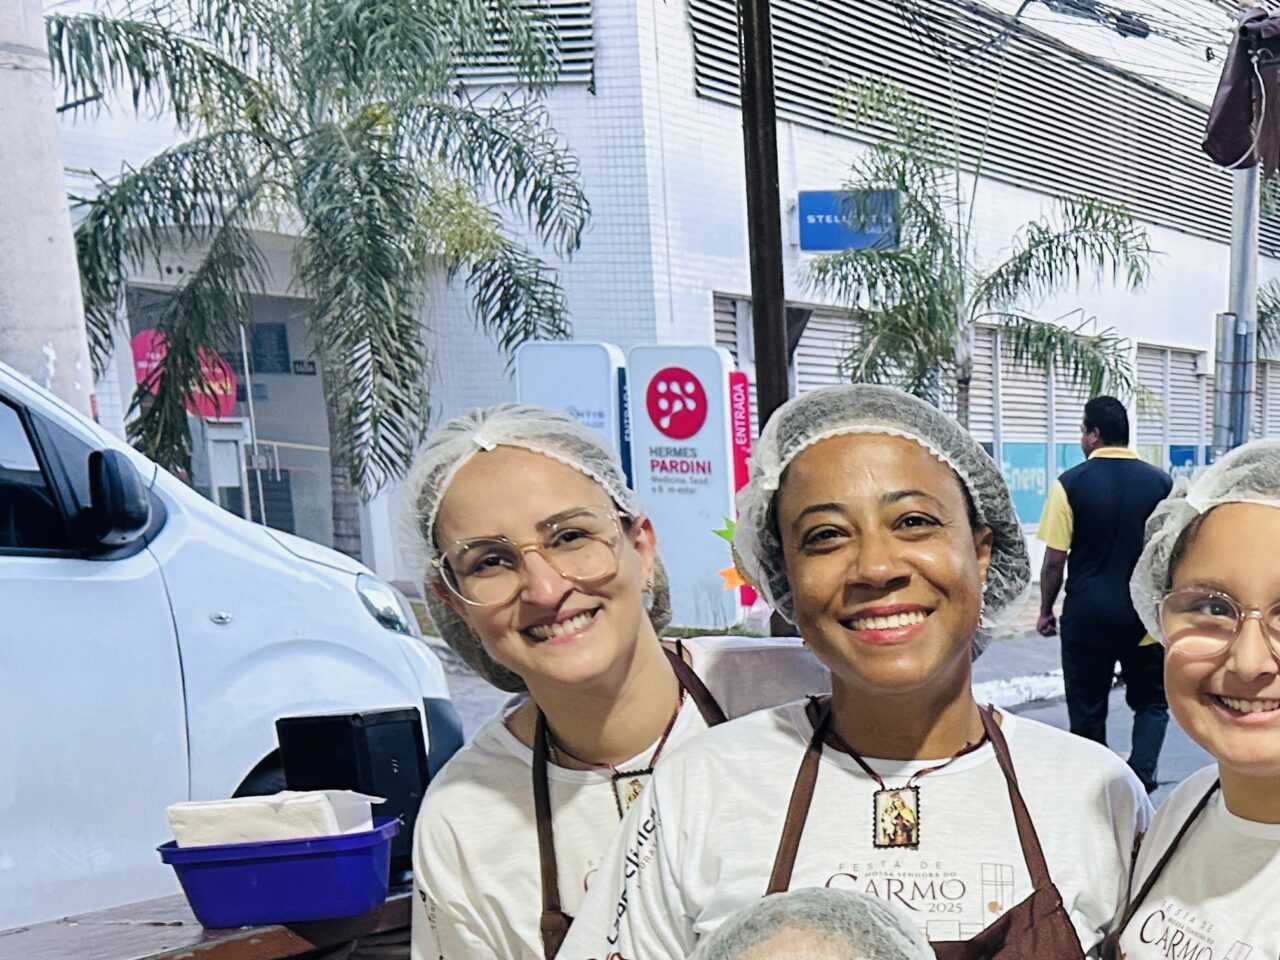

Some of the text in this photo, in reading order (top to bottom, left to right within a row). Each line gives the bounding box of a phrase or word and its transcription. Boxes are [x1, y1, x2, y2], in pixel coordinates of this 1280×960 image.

[736, 382, 747, 445] ENTRADA
[649, 446, 698, 458] HERMES
[650, 459, 712, 474] PARDINI
[838, 860, 943, 871] FESTA DE
[825, 872, 966, 912] CARMO
[928, 902, 963, 913] 2025
